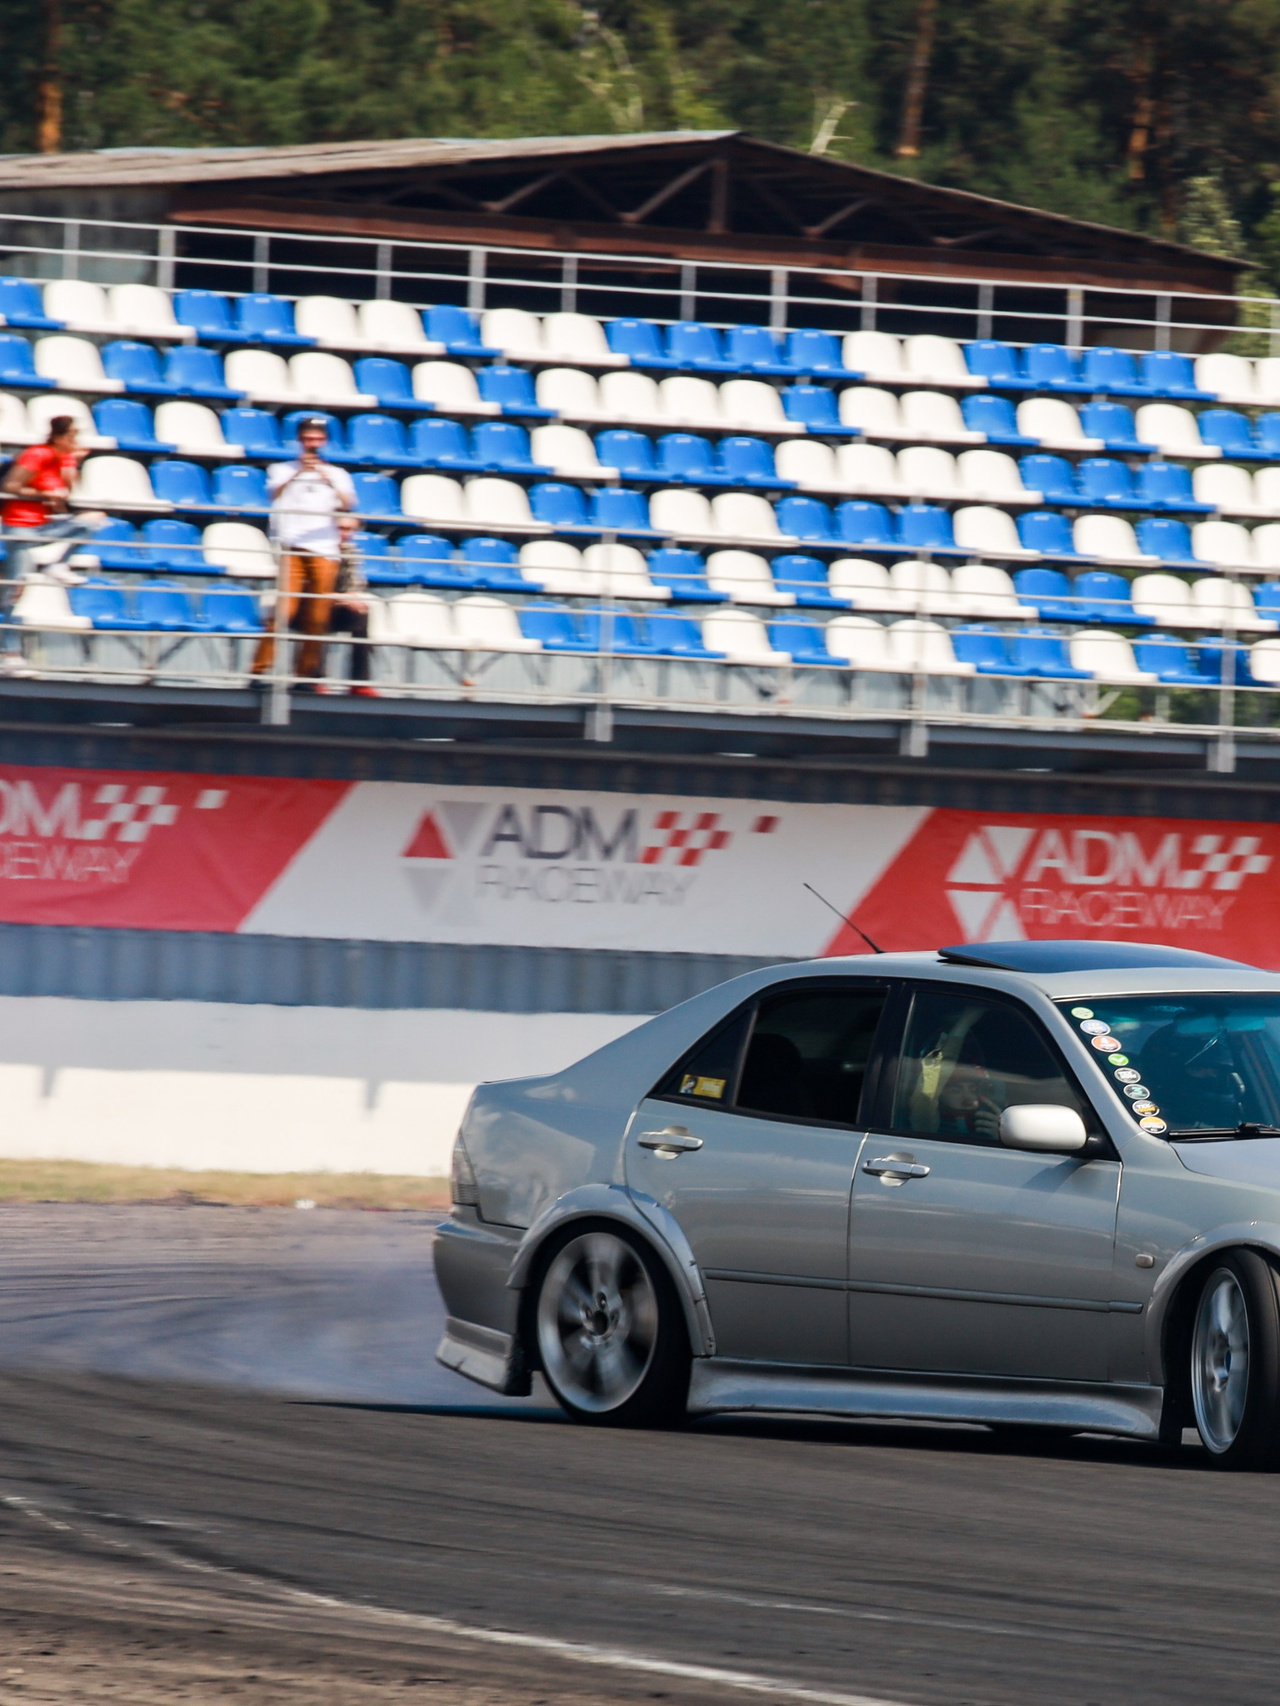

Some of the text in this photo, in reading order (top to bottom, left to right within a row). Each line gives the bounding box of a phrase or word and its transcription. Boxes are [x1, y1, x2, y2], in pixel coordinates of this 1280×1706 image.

[479, 804, 639, 863] ADM
[1024, 828, 1182, 888] ADM
[475, 864, 697, 905] RACEWAY
[1020, 888, 1236, 930] RACEWAY
